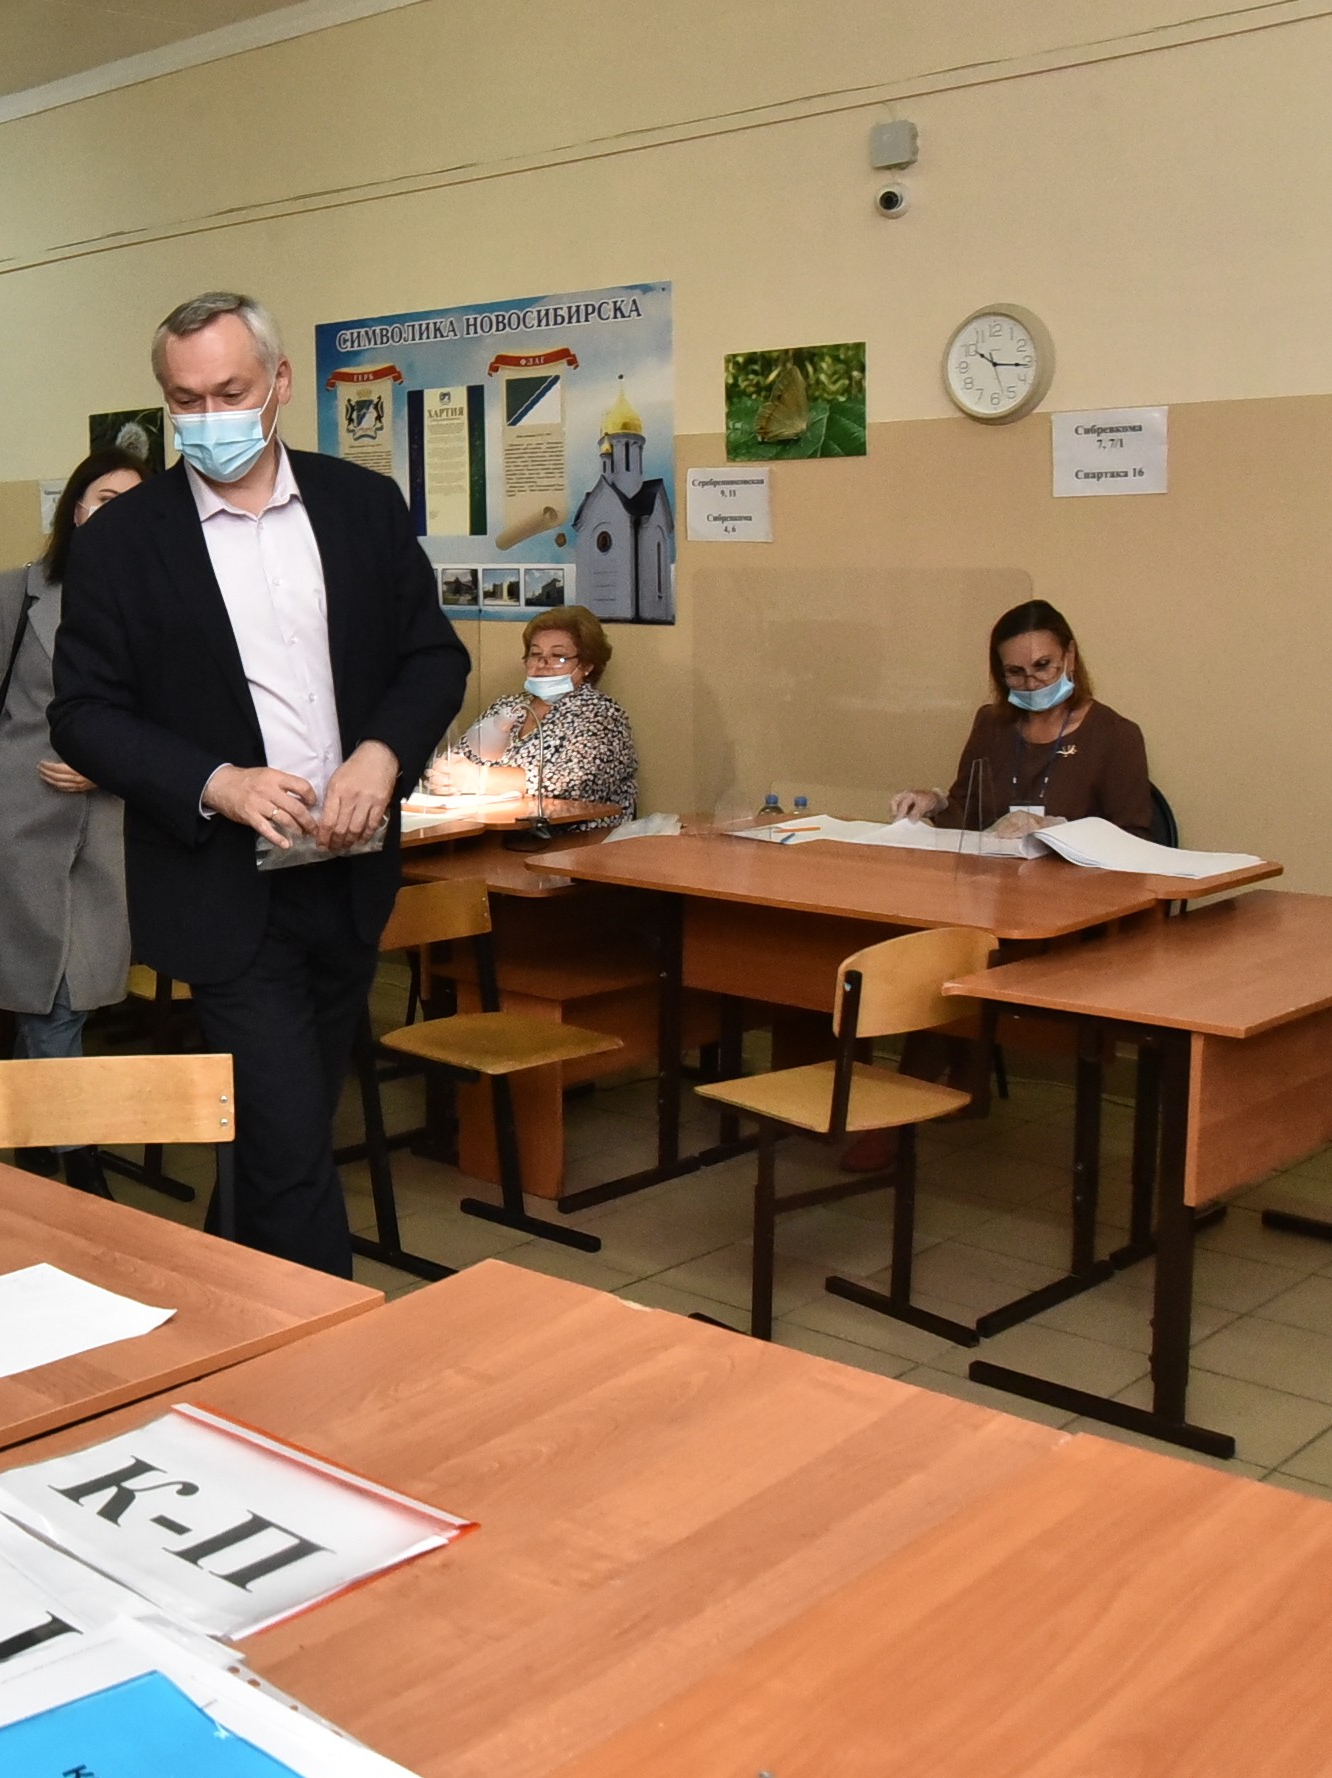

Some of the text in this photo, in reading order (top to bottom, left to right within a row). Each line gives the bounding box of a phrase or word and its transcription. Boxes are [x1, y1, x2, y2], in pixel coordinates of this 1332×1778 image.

[337, 297, 643, 351] СИМВОЛИКА НОВОСИБИРСКА
[988, 323, 1002, 338] 12
[1016, 338, 1027, 352] 2
[352, 371, 375, 383] ГЕРБ
[990, 392, 1001, 406] 6
[1006, 385, 1017, 399] 5
[426, 405, 465, 419] ХАРТИЯ
[1074, 424, 1143, 437] Сибревкома
[1074, 467, 1145, 482] Спартака 16
[47, 1455, 337, 1593] К-П
